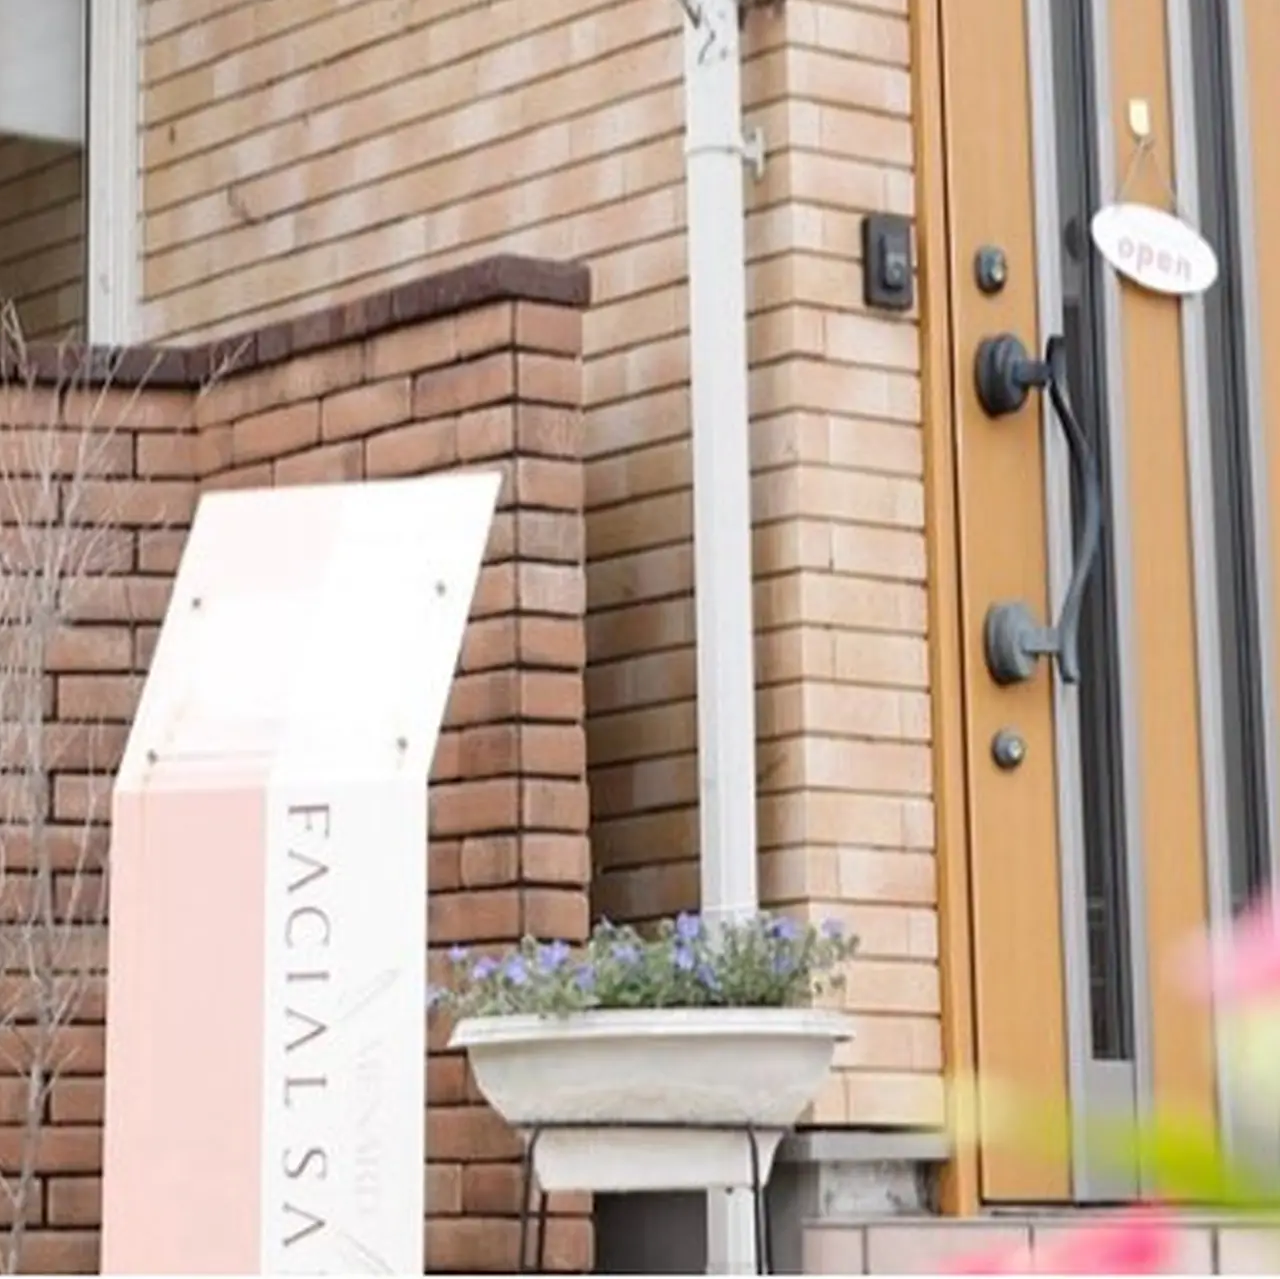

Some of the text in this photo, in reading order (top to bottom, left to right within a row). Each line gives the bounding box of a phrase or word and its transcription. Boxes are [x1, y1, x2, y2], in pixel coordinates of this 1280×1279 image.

[1117, 235, 1192, 282] open
[281, 803, 331, 1277] FACIAL SA
